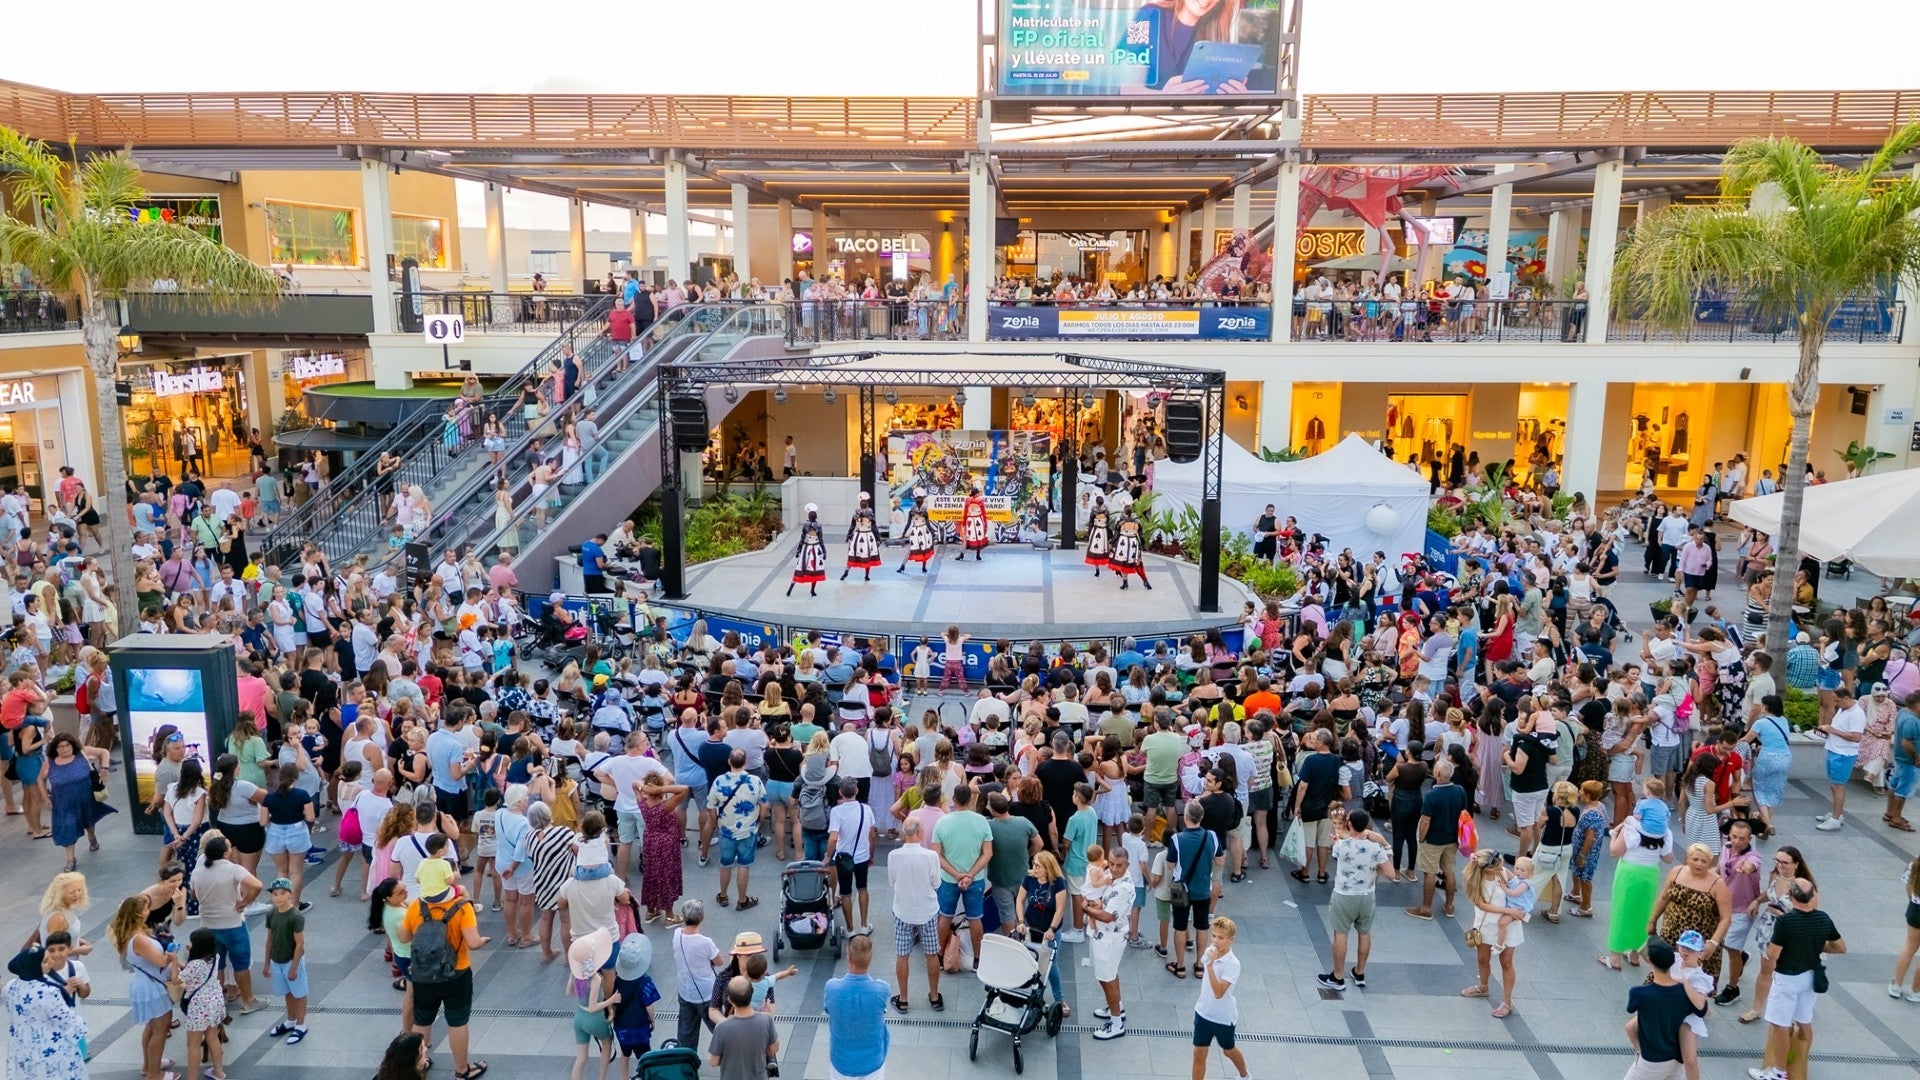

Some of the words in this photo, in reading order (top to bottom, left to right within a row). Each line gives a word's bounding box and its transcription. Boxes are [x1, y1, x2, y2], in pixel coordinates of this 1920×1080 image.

[1012, 16, 1081, 27] Matricúlate
[1084, 19, 1099, 27] en
[1013, 30, 1038, 47] FP
[1041, 29, 1104, 48] oficial
[1012, 53, 1021, 67] y
[1025, 51, 1081, 65] llévate
[1085, 55, 1104, 64] un
[835, 237, 878, 252] TACO
[881, 238, 920, 252] BELL
[1002, 316, 1039, 329] zenia
[1094, 312, 1118, 321] JULIO
[1121, 312, 1127, 321] Y
[1129, 312, 1165, 321] AGOSTO
[1218, 317, 1256, 330] zenia
[294, 354, 345, 379] Bershka
[154, 367, 222, 397] Bershka
[955, 440, 985, 450] zenia
